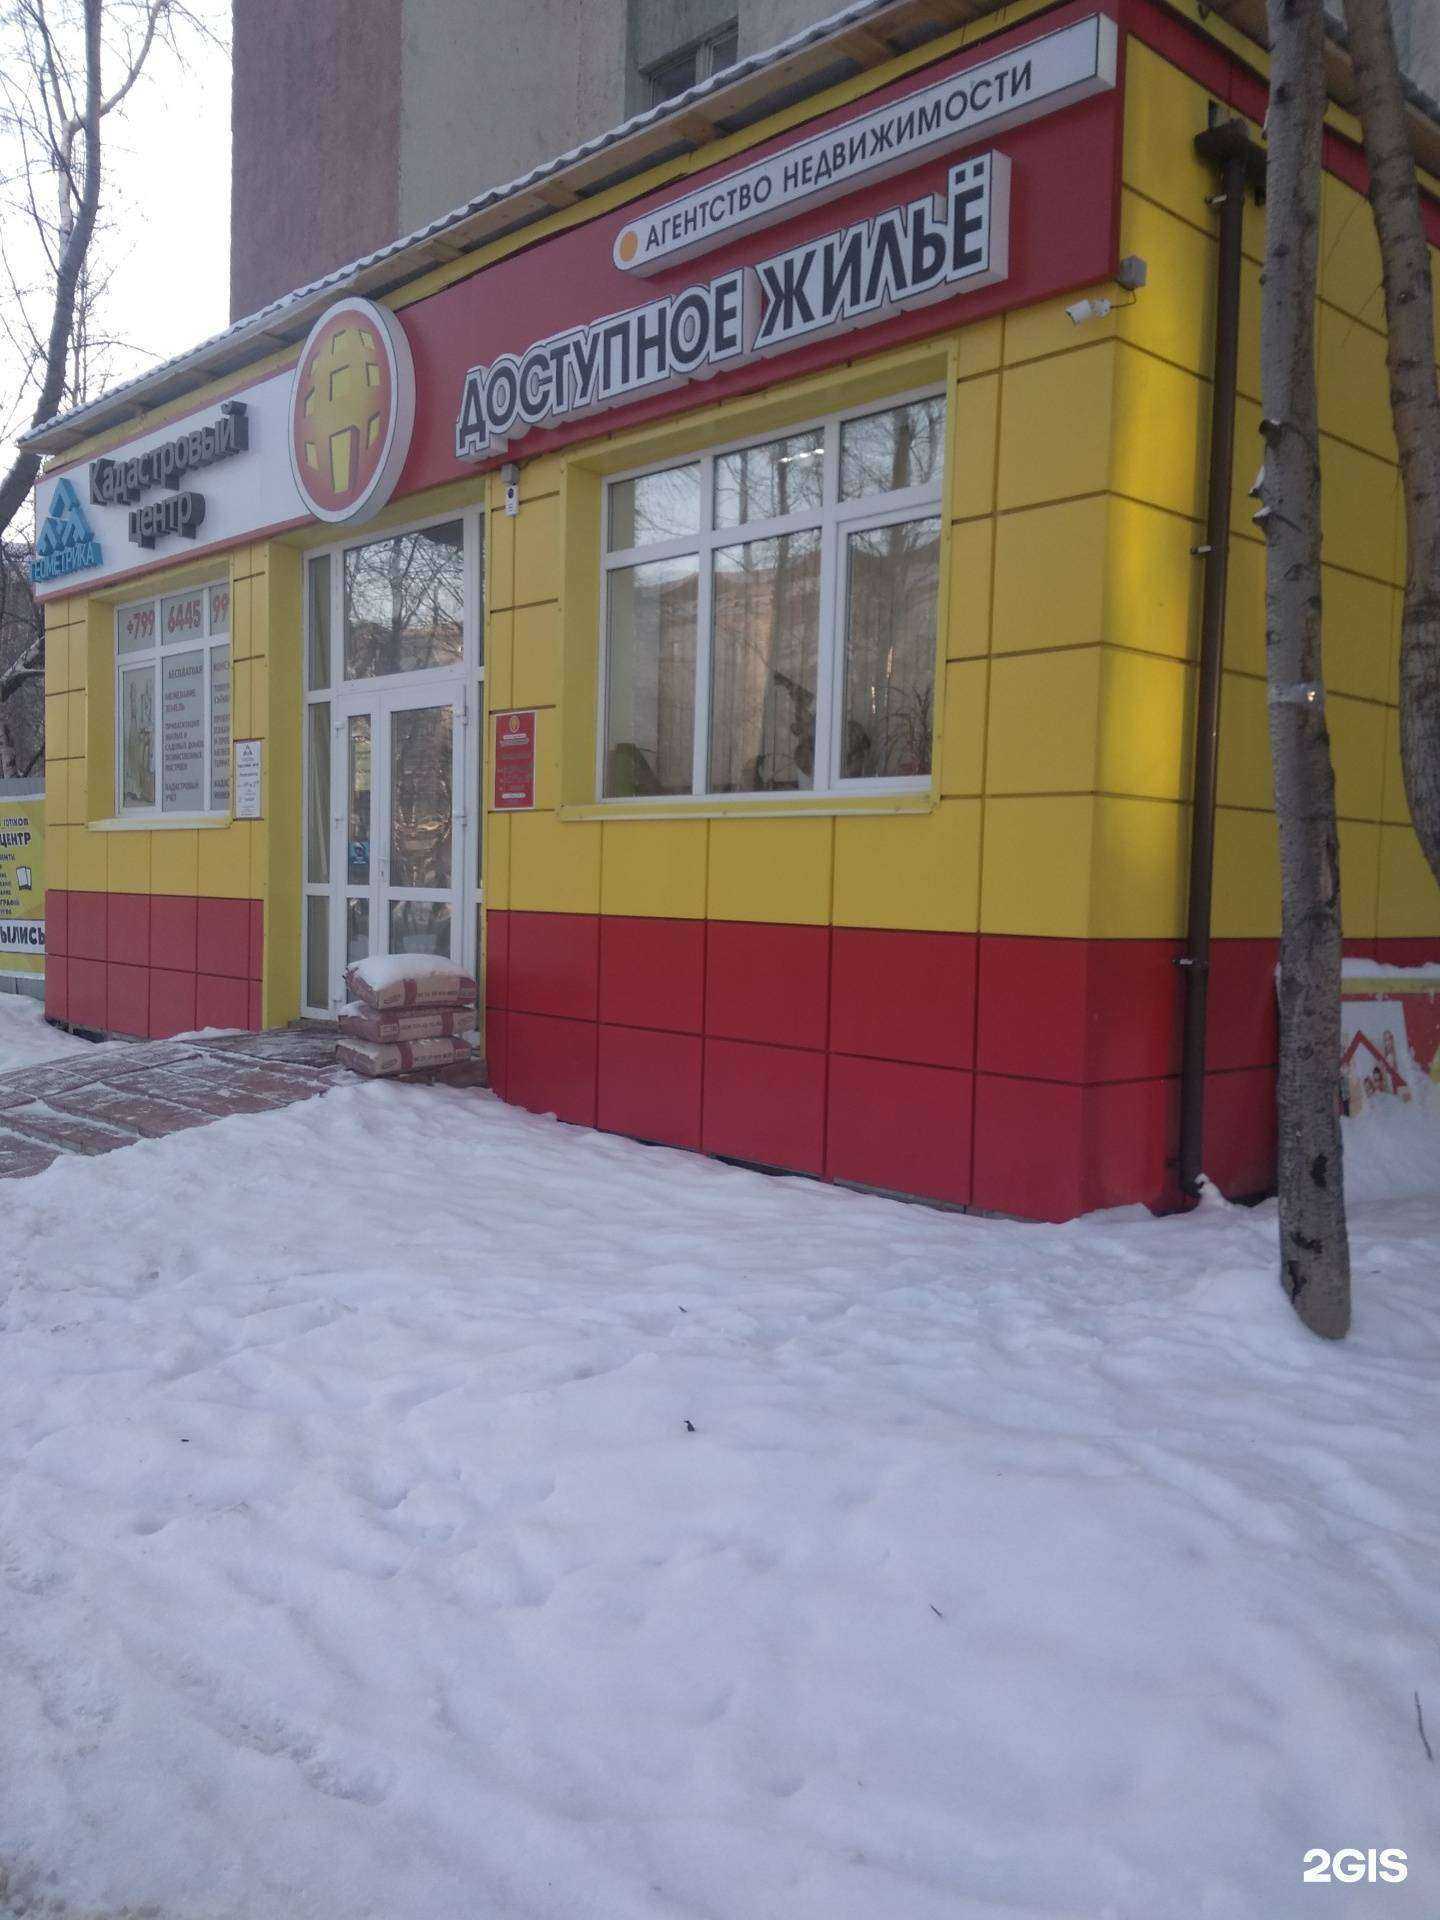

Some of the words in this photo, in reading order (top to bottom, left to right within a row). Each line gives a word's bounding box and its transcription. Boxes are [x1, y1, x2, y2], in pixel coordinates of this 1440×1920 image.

[644, 174, 772, 251] АГЕНТСТВО
[782, 60, 1033, 193] НЕДВИЖИМОСТИ
[458, 279, 739, 451] ДОСТУПНОЕ
[761, 160, 985, 338] ЖИЛЬЁ
[88, 401, 247, 506] Кадастровый
[31, 541, 103, 583] ГЕОМЕТРИКА
[128, 491, 205, 549] центр
